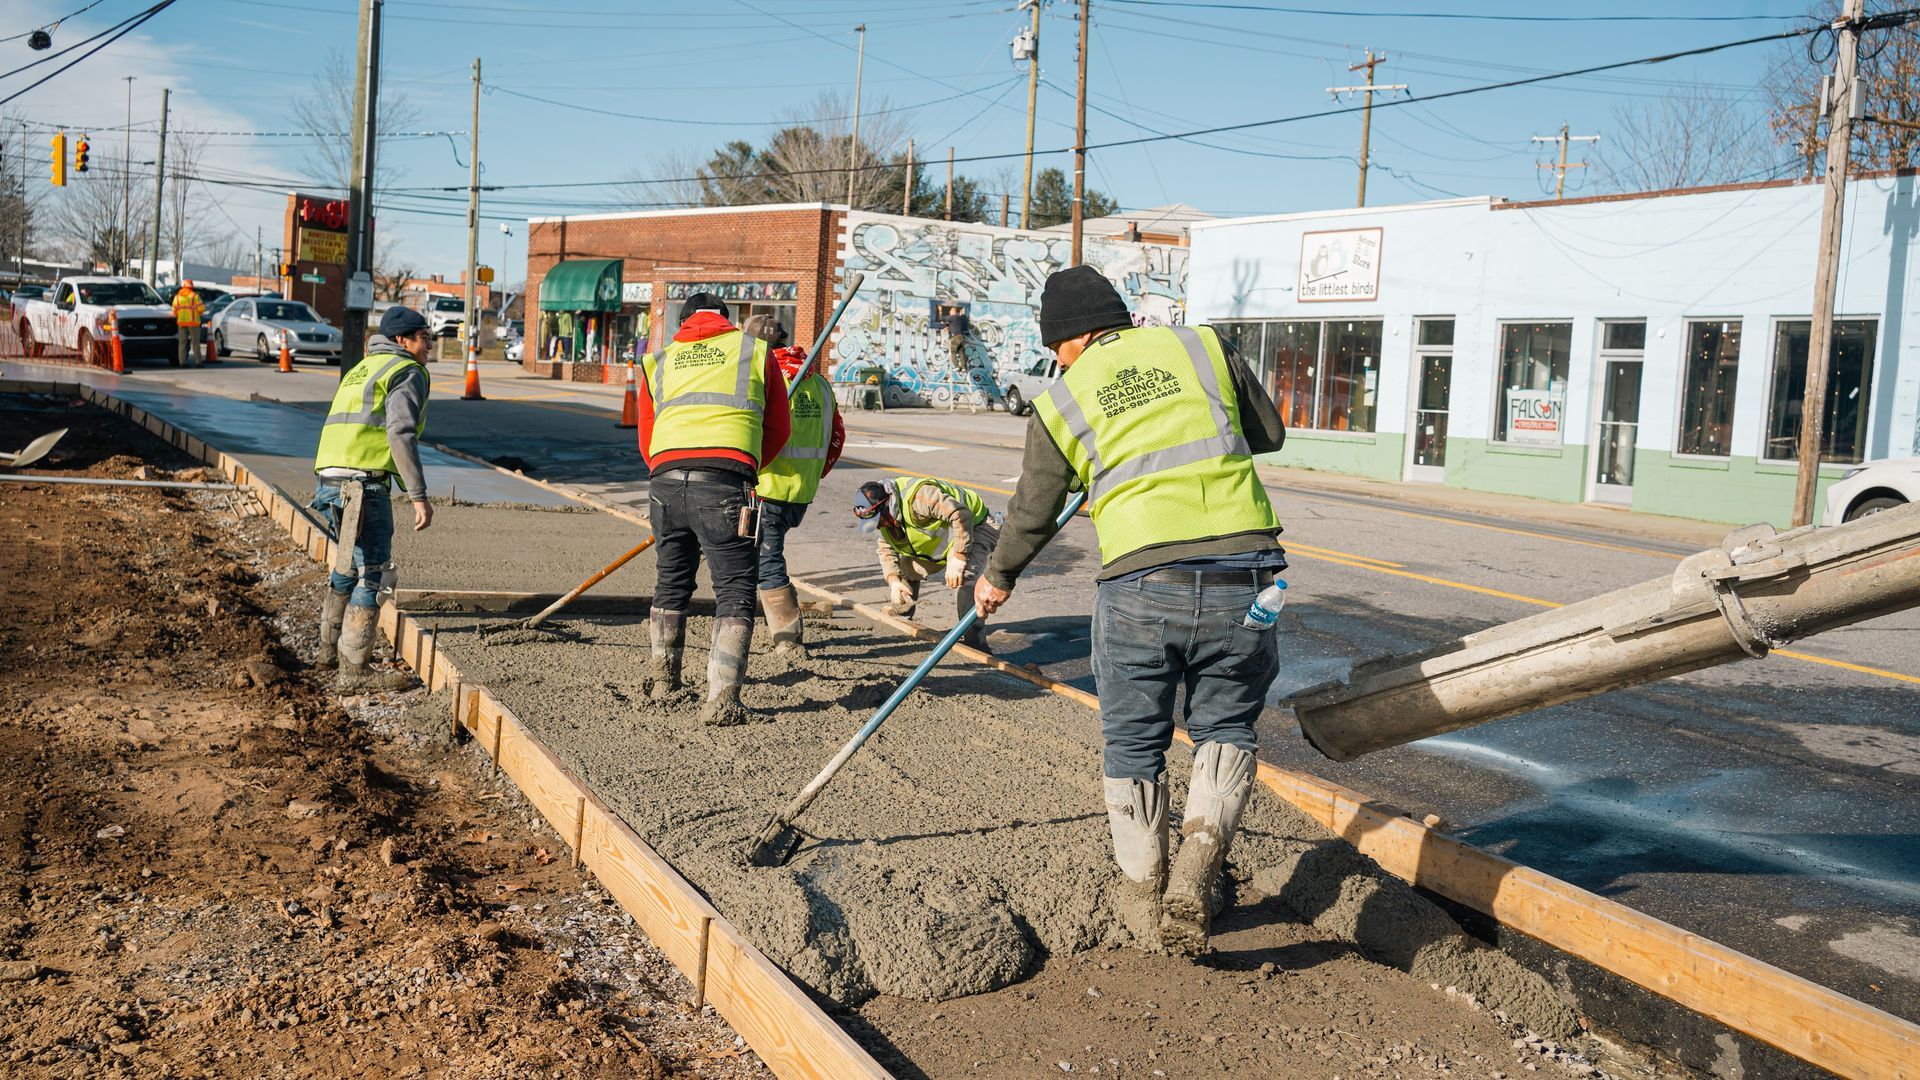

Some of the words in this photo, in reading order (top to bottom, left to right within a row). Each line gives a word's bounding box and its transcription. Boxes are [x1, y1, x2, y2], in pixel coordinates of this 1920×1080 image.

[1302, 283, 1316, 296] the
[1319, 282, 1349, 296] littlest
[1351, 281, 1374, 295] birds
[674, 353, 713, 362] GRADING
[1096, 370, 1154, 397] ARGUETA'S
[1099, 379, 1156, 406] GRADING
[1103, 402, 1119, 412] AND
[1120, 387, 1162, 405] CONCRETE
[1164, 380, 1180, 390] LLC
[1105, 387, 1182, 418] 828-989-4869
[1511, 398, 1561, 431] FALCON
